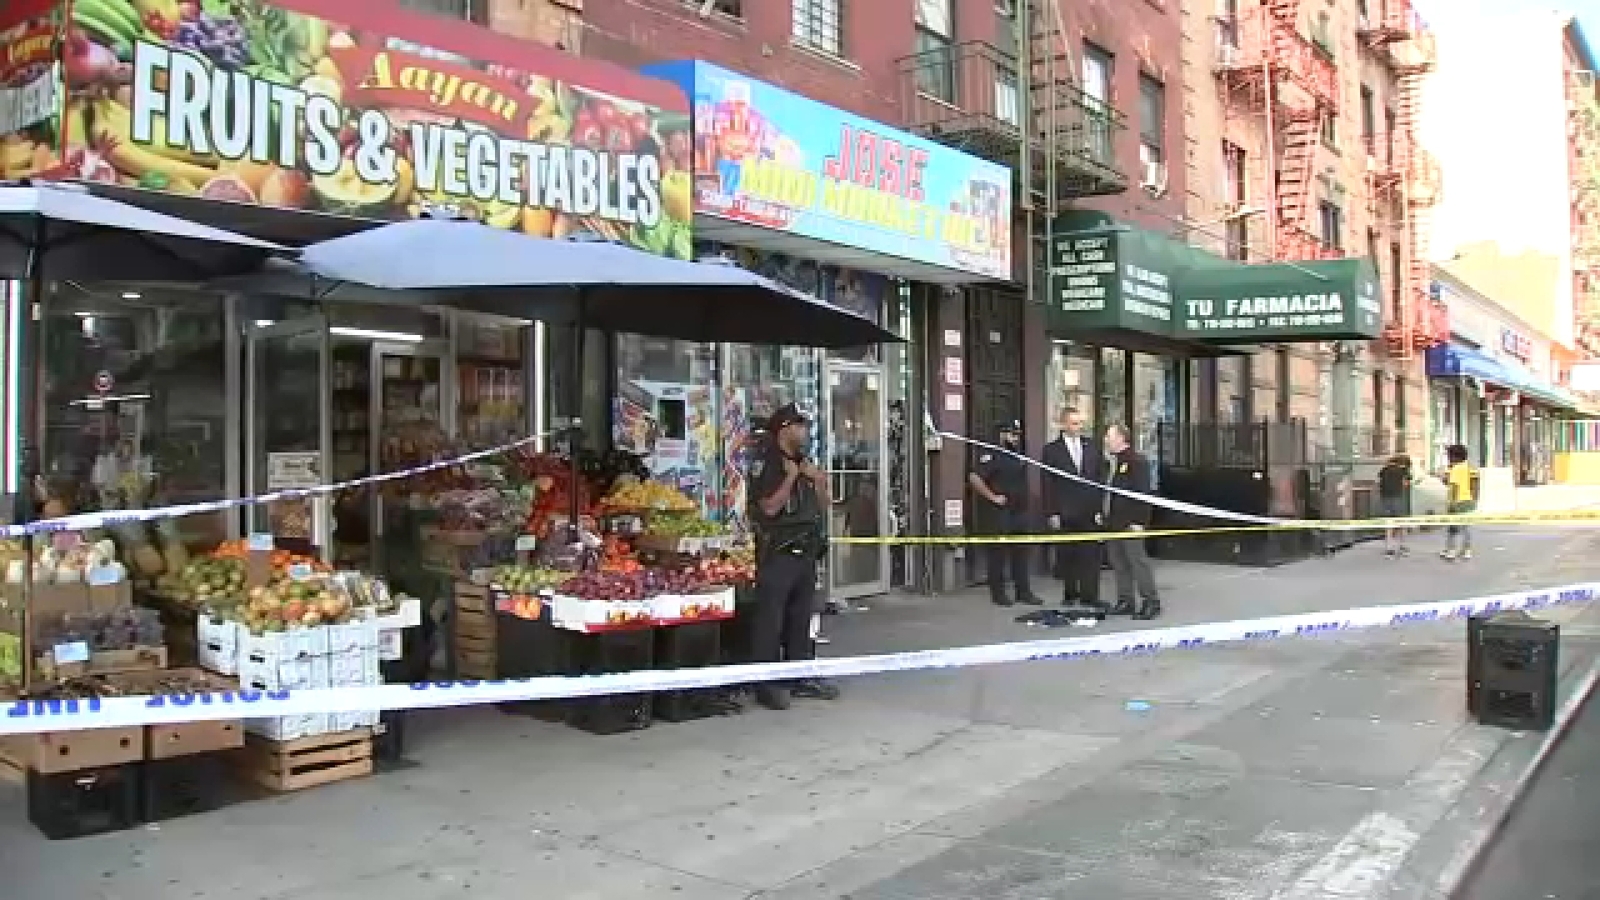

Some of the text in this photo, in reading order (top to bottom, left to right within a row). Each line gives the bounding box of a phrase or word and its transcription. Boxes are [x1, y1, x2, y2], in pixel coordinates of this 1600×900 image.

[358, 52, 519, 121] Aayan
[130, 38, 341, 177] FRUITS
[354, 108, 397, 186] &
[410, 121, 664, 229] VEGETABLES
[823, 122, 931, 201] JOSE
[1185, 299, 1214, 317] TU
[1225, 292, 1342, 316] FARMACIA
